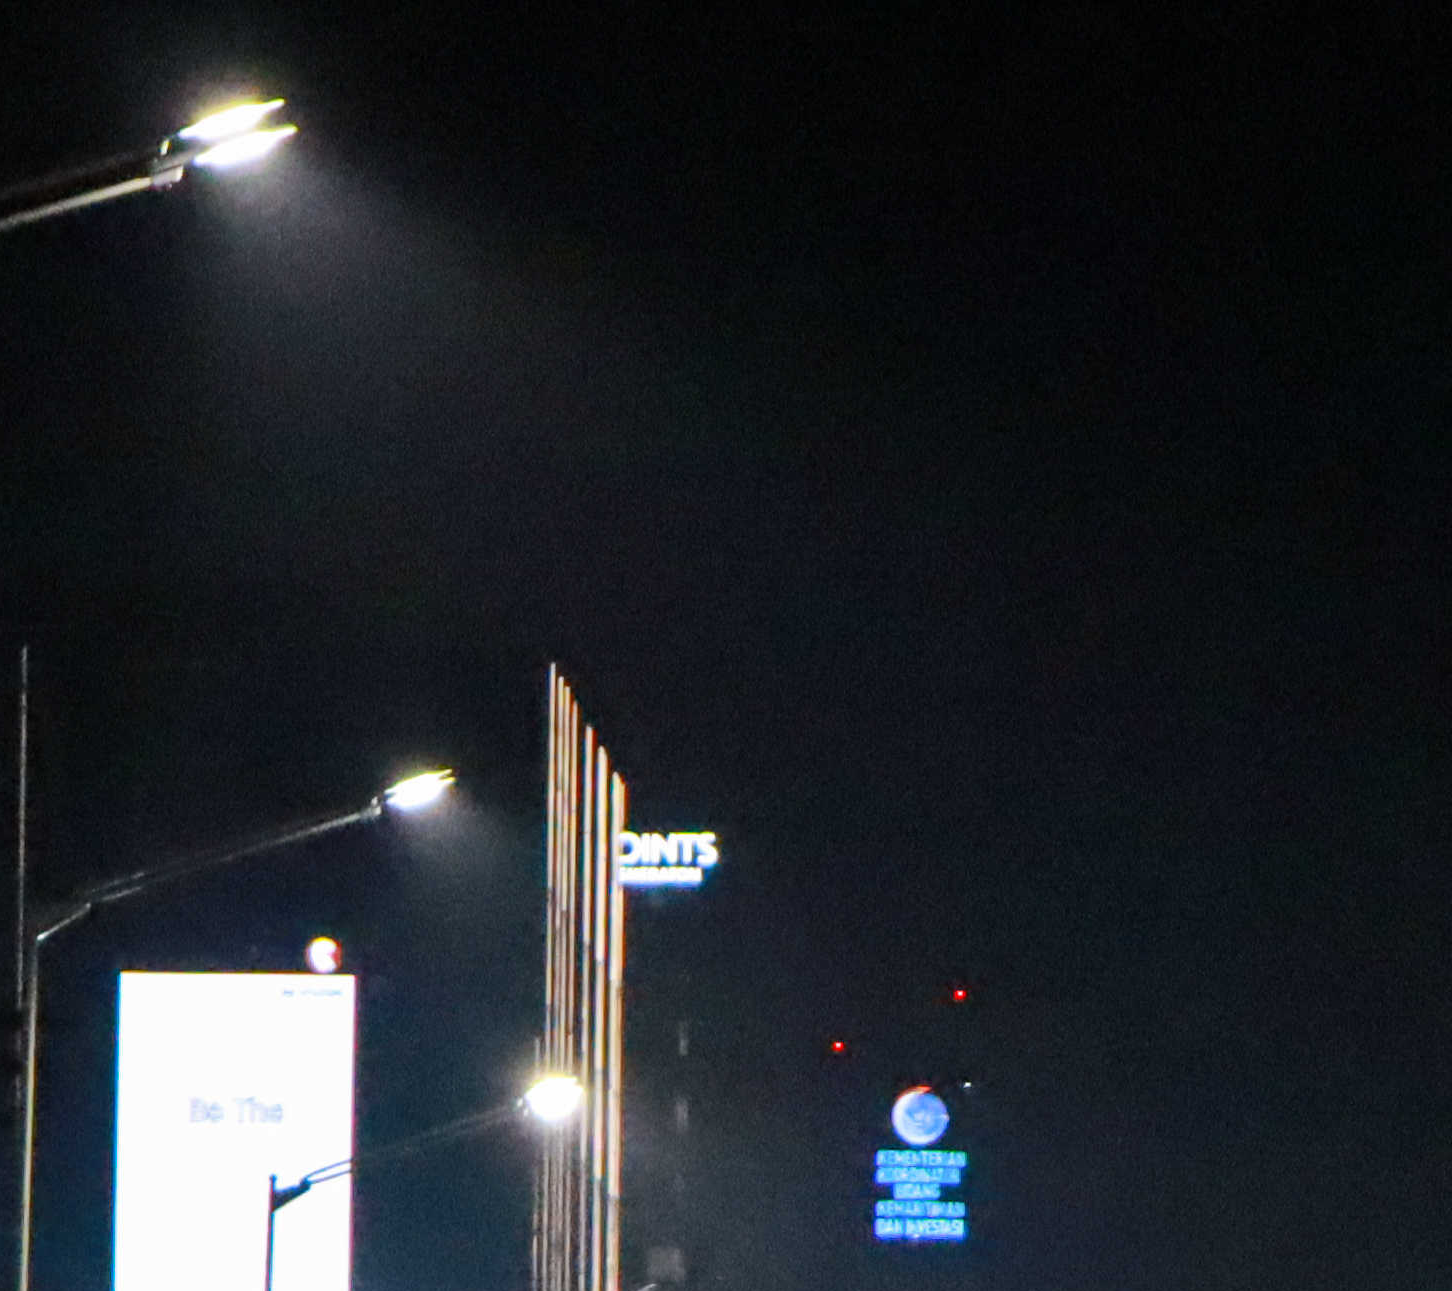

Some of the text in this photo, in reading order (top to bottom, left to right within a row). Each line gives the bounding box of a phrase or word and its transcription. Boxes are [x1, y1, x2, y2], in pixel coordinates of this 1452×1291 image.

[619, 831, 718, 867] OINTS
[189, 1096, 284, 1124] Be The
